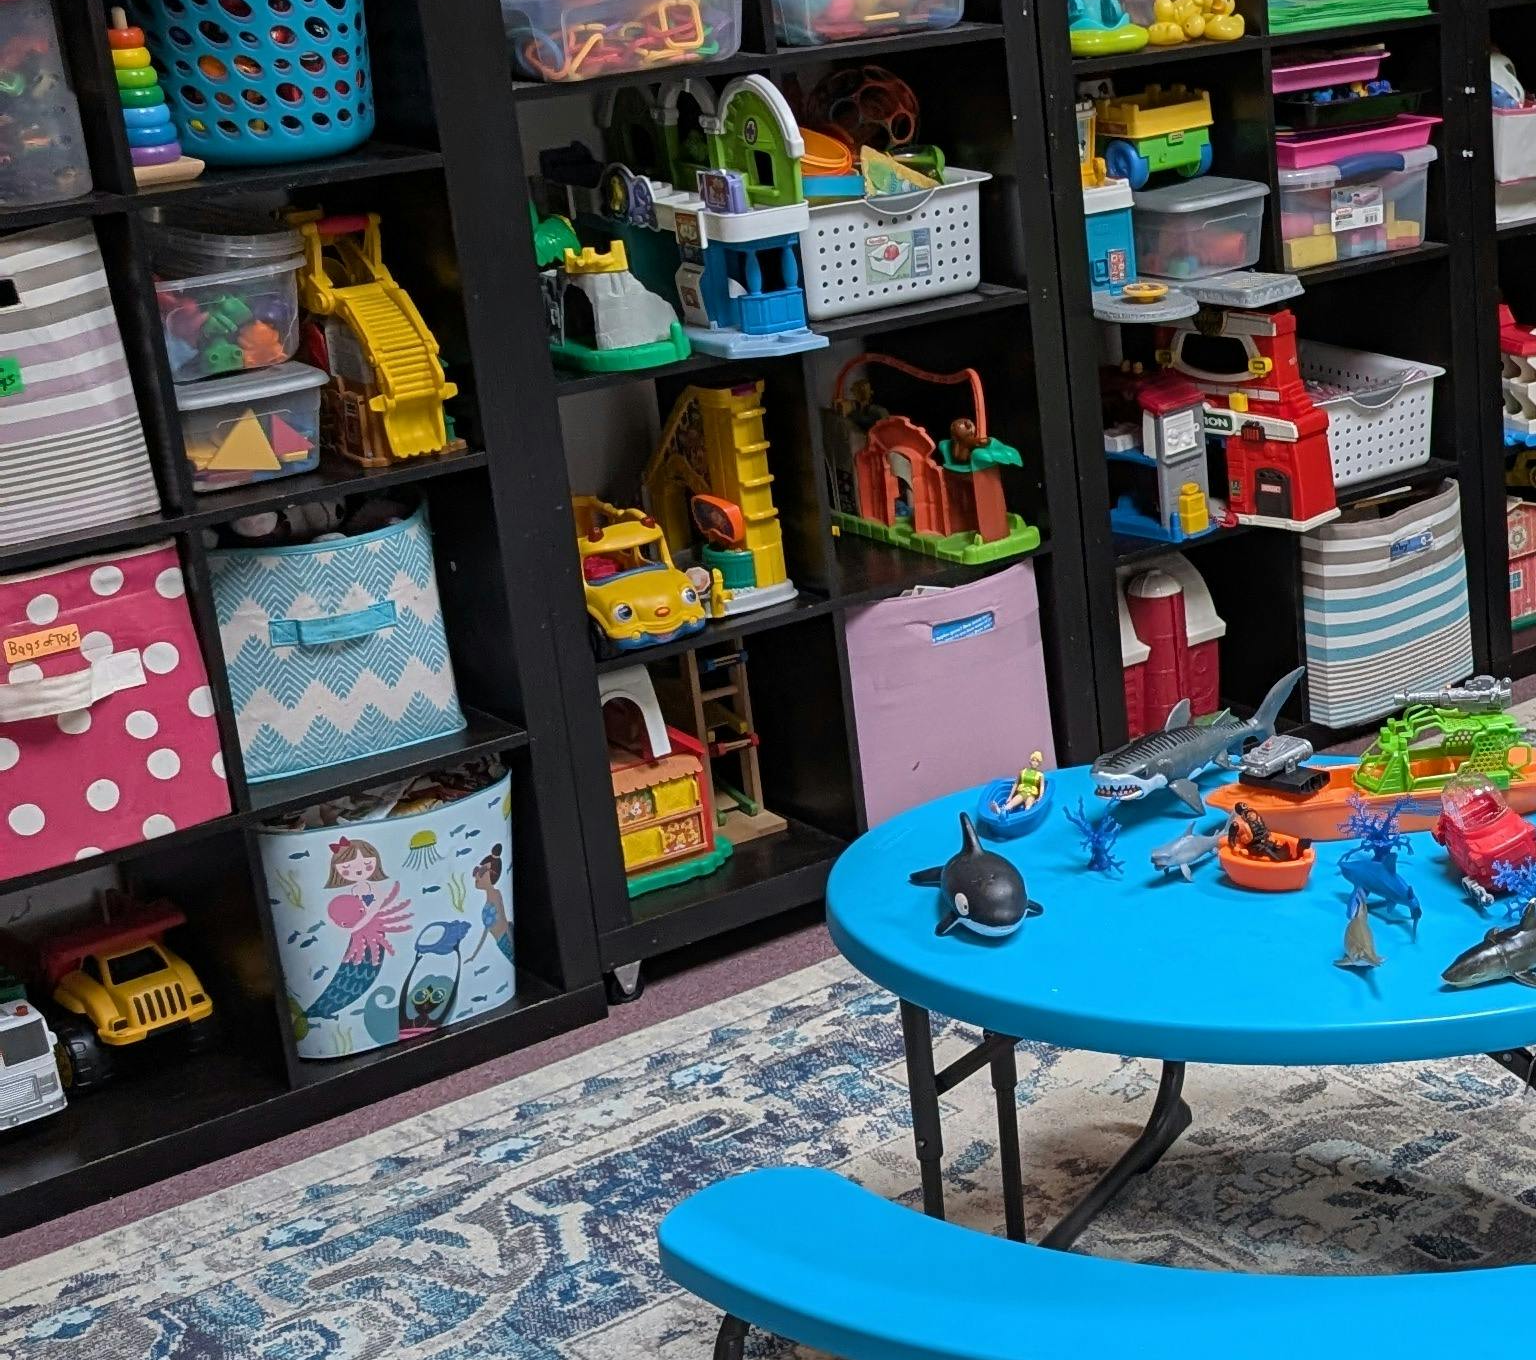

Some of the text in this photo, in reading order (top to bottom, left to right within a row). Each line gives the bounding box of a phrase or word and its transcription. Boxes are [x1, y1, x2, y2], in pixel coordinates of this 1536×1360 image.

[8, 630, 78, 656] Bags of Toys
